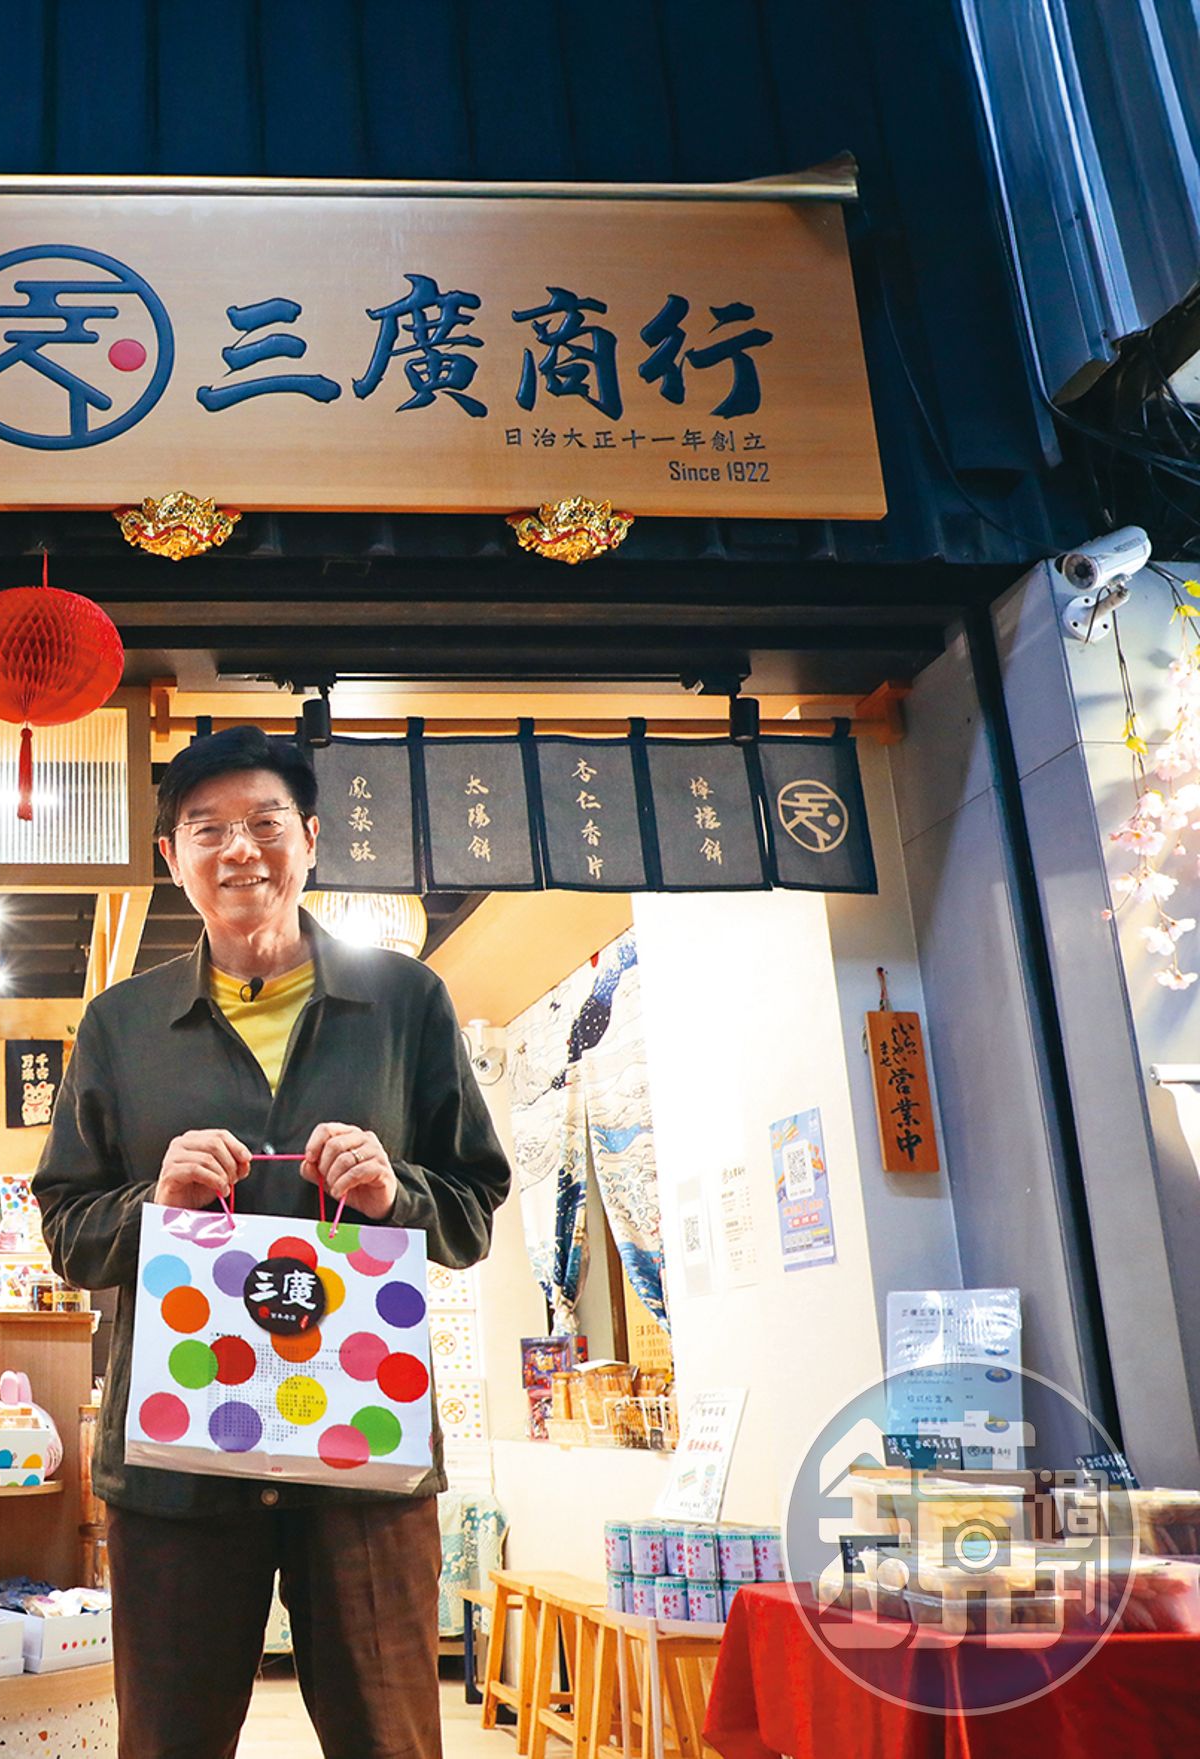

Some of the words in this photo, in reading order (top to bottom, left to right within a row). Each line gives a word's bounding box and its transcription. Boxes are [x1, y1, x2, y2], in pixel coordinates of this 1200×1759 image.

[196, 273, 774, 421] 三廣商行
[505, 427, 766, 452] 日治大正十一年創立
[669, 460, 720, 482] Since
[727, 461, 770, 482] 1922
[464, 774, 491, 862] 太陽餅
[572, 758, 604, 880] 杏仁香片
[249, 1269, 317, 1310] 三廣
